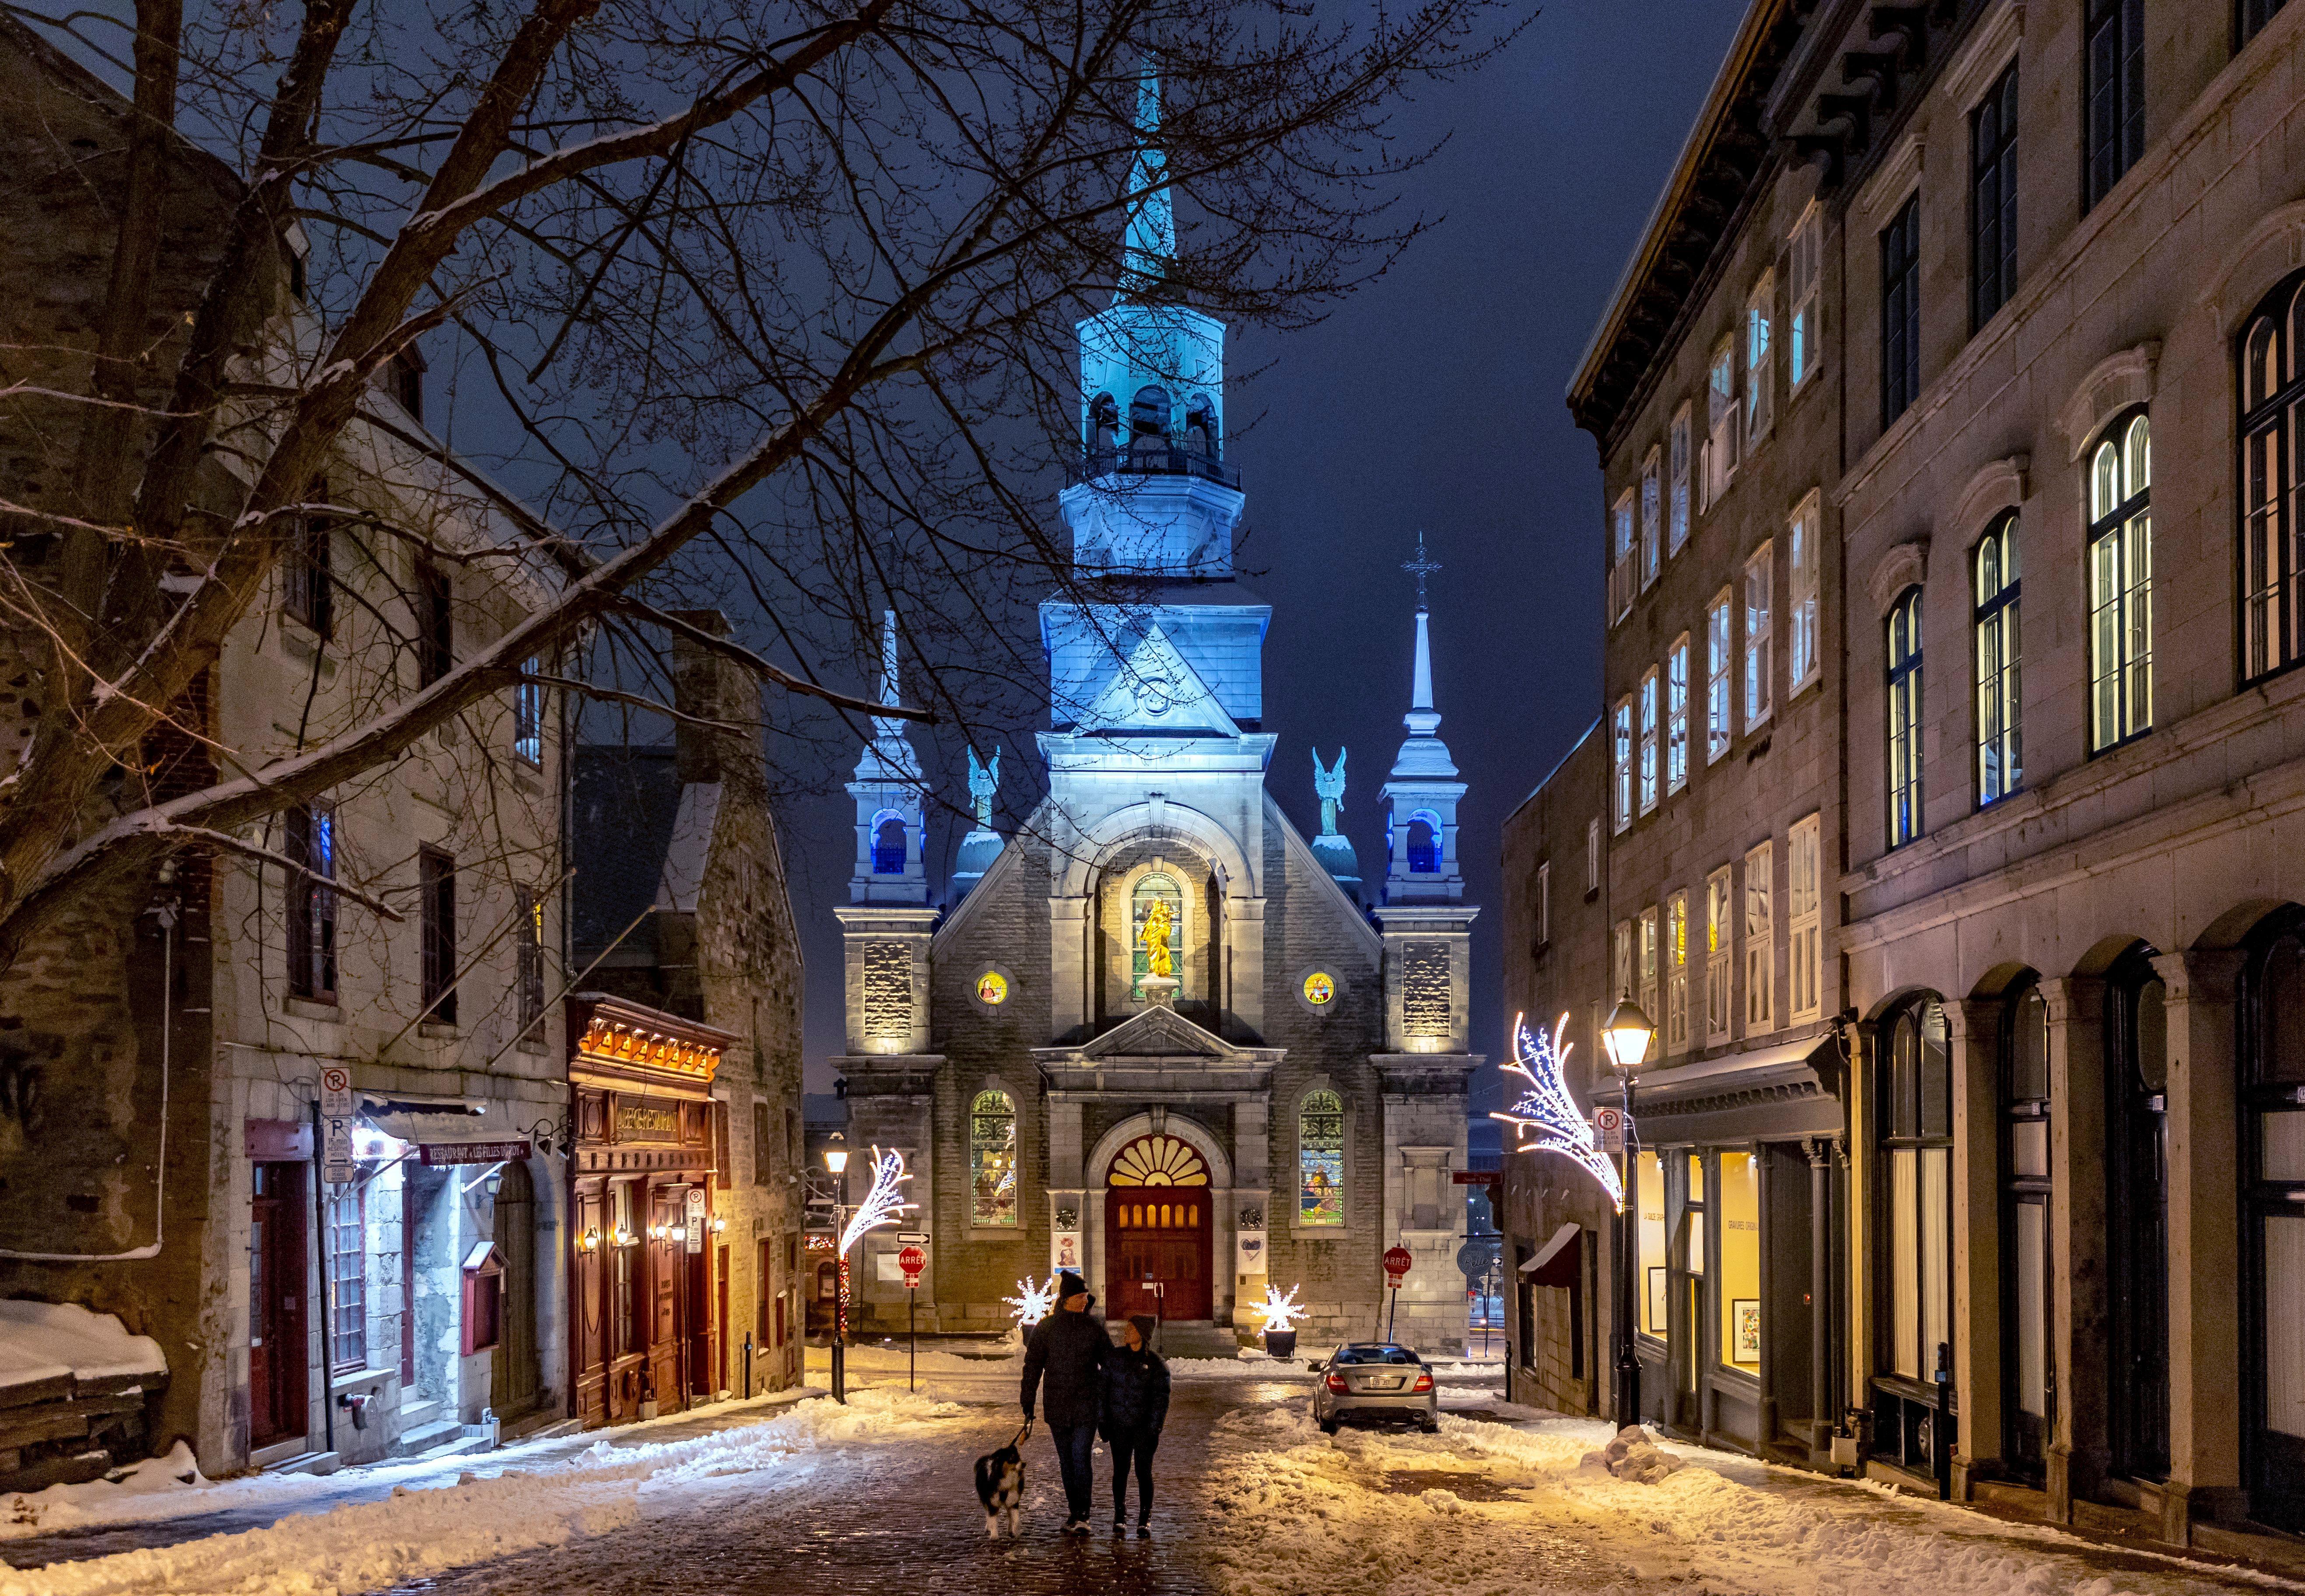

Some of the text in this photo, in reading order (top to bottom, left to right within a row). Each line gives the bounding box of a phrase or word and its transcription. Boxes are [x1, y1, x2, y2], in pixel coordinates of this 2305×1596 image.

[332, 1120, 343, 1136] P
[430, 1147, 468, 1160] RESTAURANT
[483, 1145, 500, 1158] FILLES
[900, 1255, 924, 1264] ARRÊT
[1384, 1256, 1410, 1267] ARRÊT
